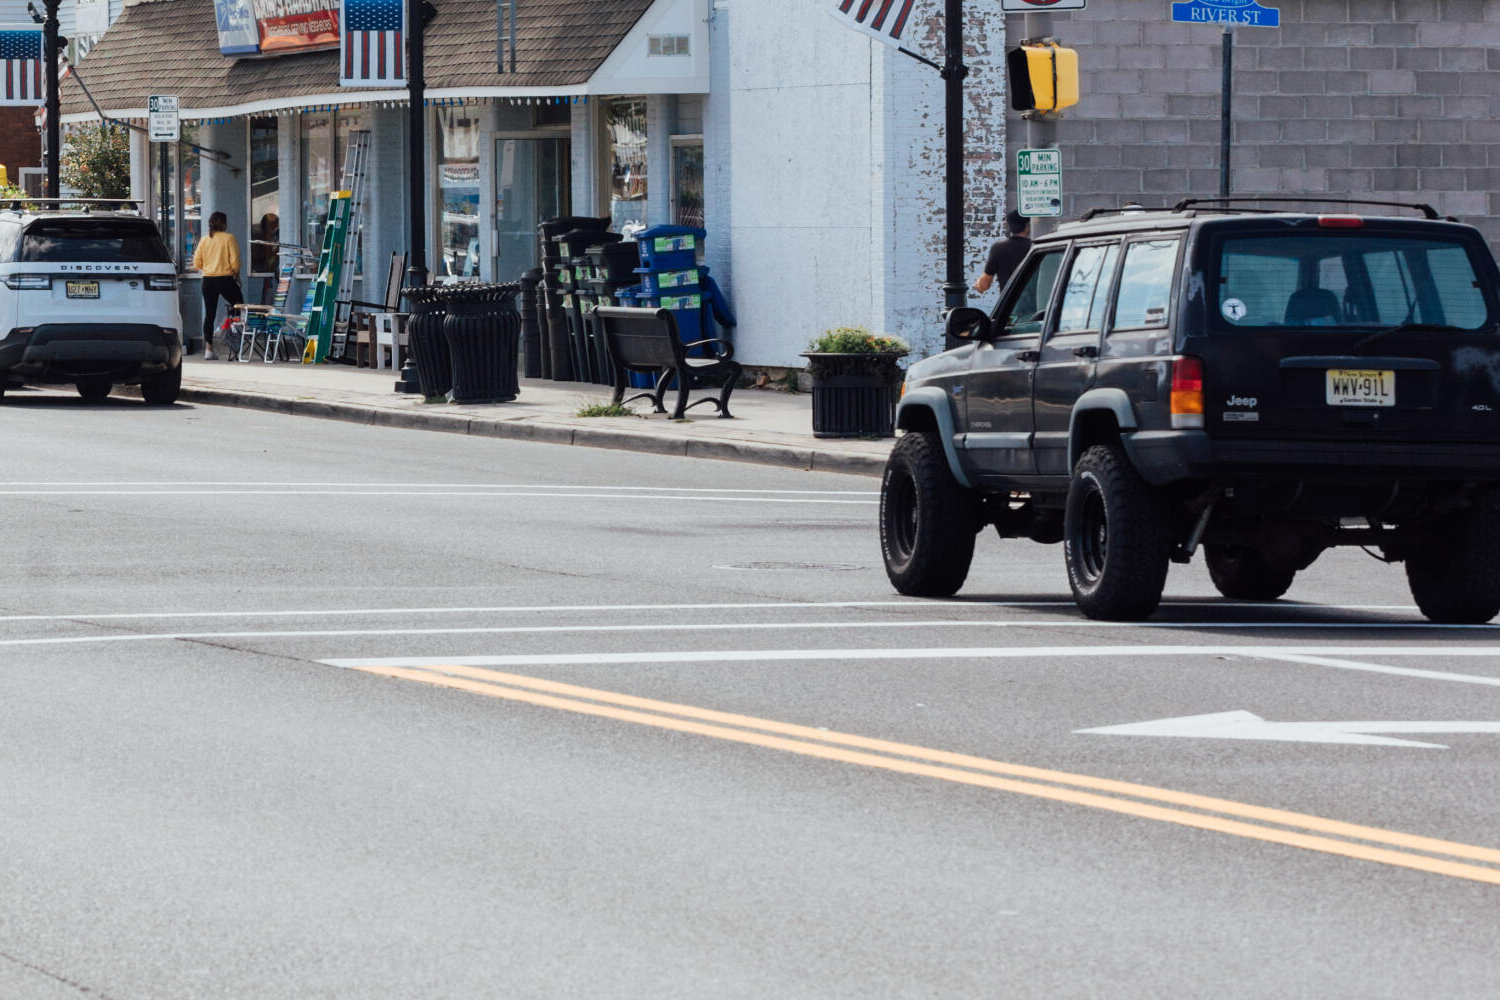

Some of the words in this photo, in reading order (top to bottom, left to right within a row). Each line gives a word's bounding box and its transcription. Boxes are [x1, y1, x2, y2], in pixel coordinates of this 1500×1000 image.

[1191, 7, 1237, 22] RIVER
[1242, 10, 1261, 24] ST
[308, 19, 332, 33] NEIGHBORS
[150, 98, 158, 110] 30
[1019, 155, 1030, 170] 30
[1037, 153, 1052, 161] MIN
[1031, 163, 1058, 172] PARKING
[1021, 179, 1028, 188] 10
[1049, 179, 1058, 187] PM
[1226, 395, 1258, 408] Jeep
